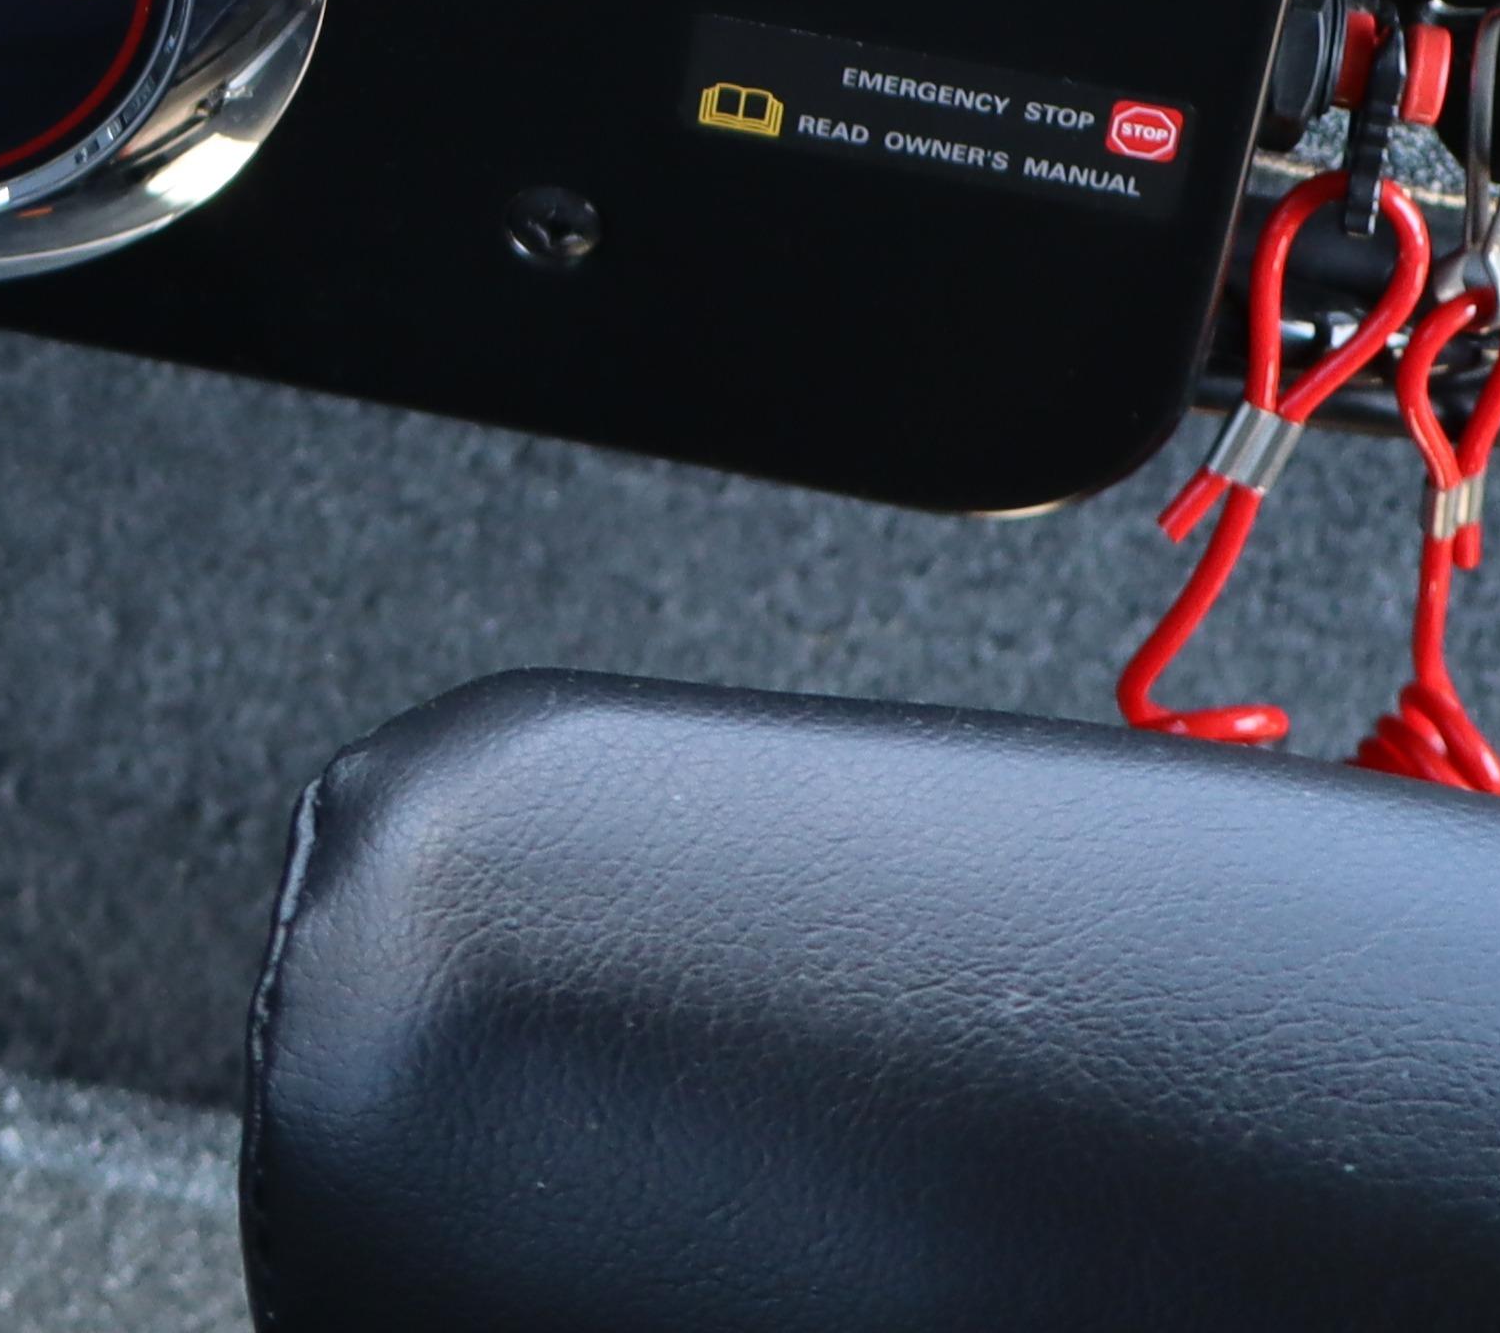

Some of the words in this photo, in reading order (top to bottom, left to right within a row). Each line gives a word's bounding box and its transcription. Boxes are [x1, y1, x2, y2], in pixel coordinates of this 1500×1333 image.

[841, 66, 1010, 115] EMERGENCY
[1024, 101, 1096, 131] STOP
[798, 114, 870, 144] READ
[884, 131, 1009, 171] OWNER'S
[1023, 156, 1141, 197] MANUAL
[1121, 121, 1169, 142] STOP
